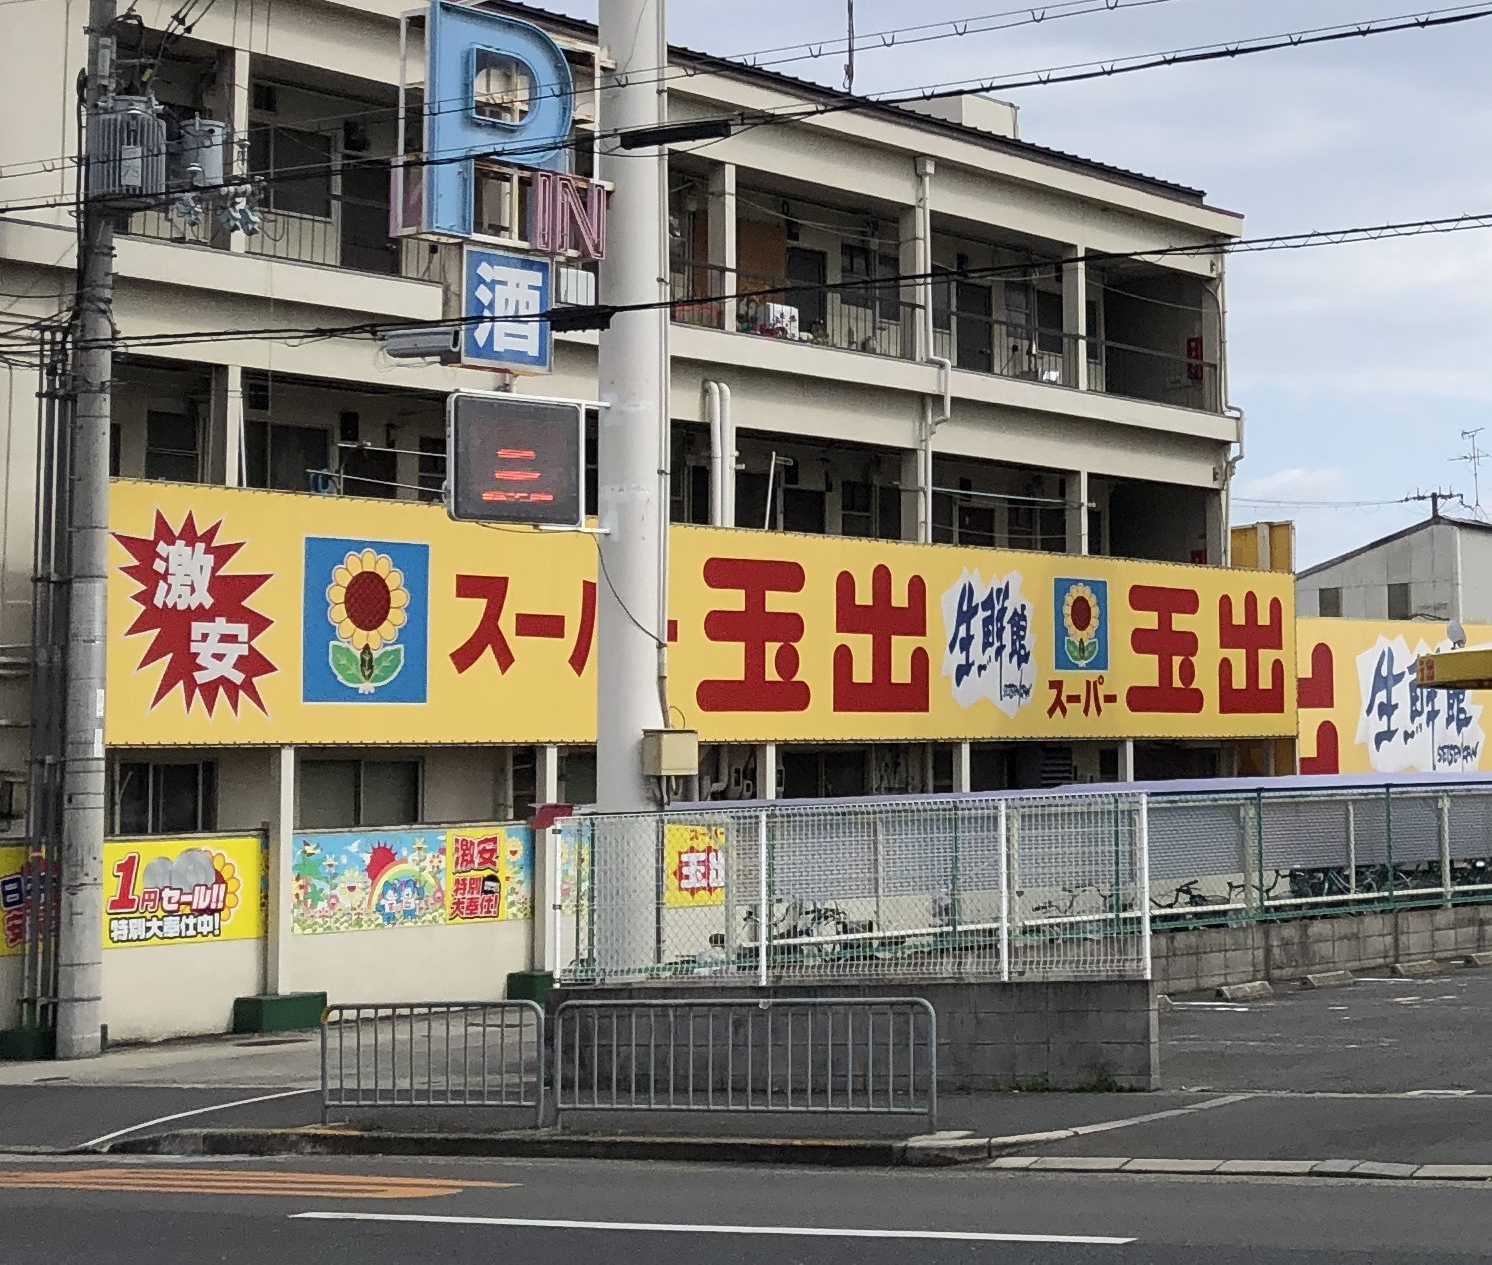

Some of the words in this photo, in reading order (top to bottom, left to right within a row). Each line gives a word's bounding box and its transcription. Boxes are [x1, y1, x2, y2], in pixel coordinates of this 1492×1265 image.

[526, 171, 606, 261] IN
[473, 261, 545, 357] 酒
[152, 539, 250, 686] 激安
[696, 557, 930, 713] 玉出
[948, 580, 1031, 701] 生鮮館
[1126, 584, 1286, 715] 玉出
[1046, 674, 1118, 719] スーパー
[108, 853, 227, 913] 1円セール!!
[454, 836, 500, 871] 激安
